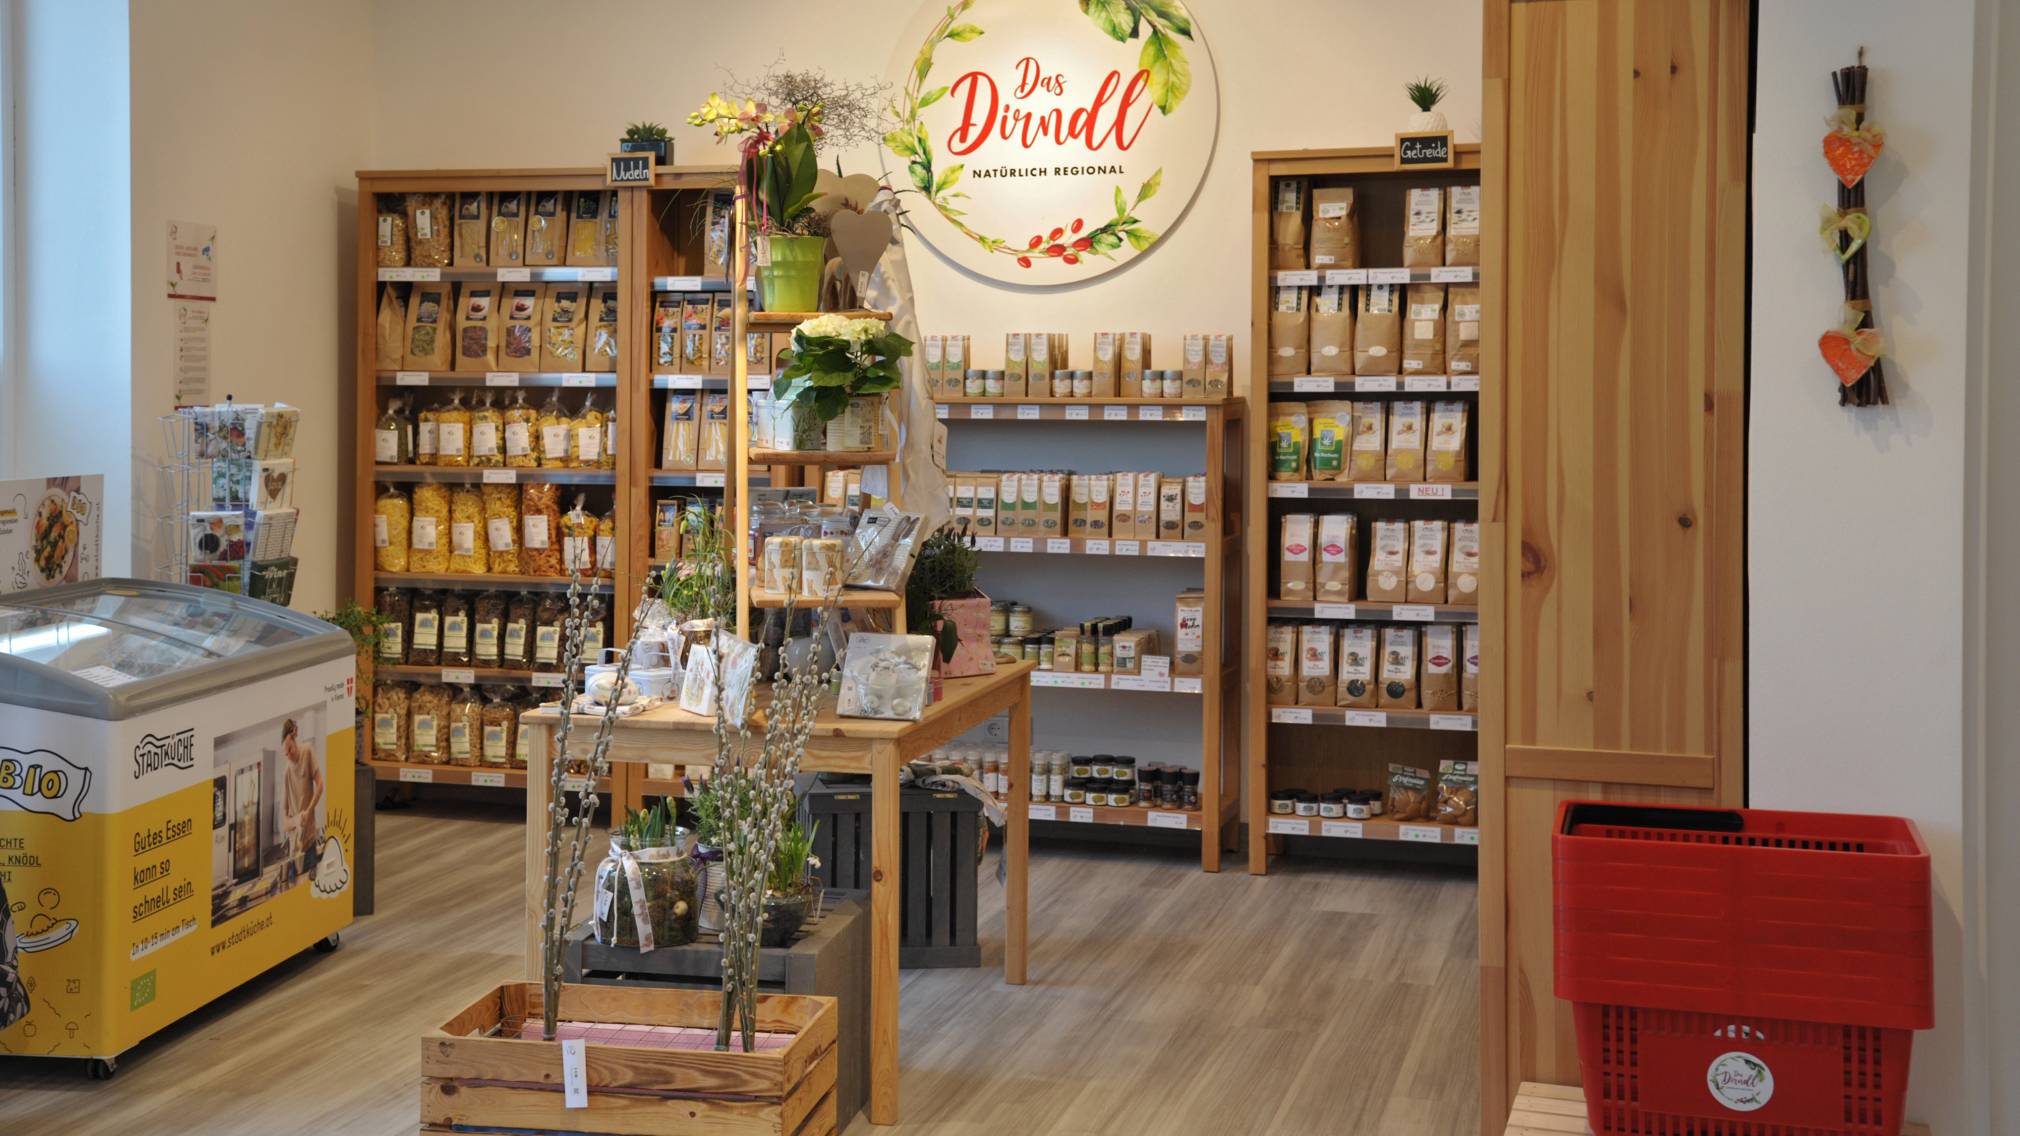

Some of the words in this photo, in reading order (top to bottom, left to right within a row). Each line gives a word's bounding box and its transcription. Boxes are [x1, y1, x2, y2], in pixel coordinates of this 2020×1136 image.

[1013, 57, 1067, 100] Das
[947, 70, 1154, 156] Dirndl
[1401, 141, 1448, 159] Getreide
[612, 161, 649, 180] Nudeln
[972, 165, 1048, 180] NATÜRLICH
[1054, 164, 1125, 177] REGIONAL
[0, 758, 68, 800] BIO
[133, 828, 163, 853] Gutes
[166, 817, 192, 841] Essen
[8, 853, 41, 866] KNÖDL
[133, 864, 157, 886] kann
[159, 858, 171, 875] so
[132, 885, 171, 919] schnell
[172, 878, 195, 901] sein.
[159, 928, 171, 943] min
